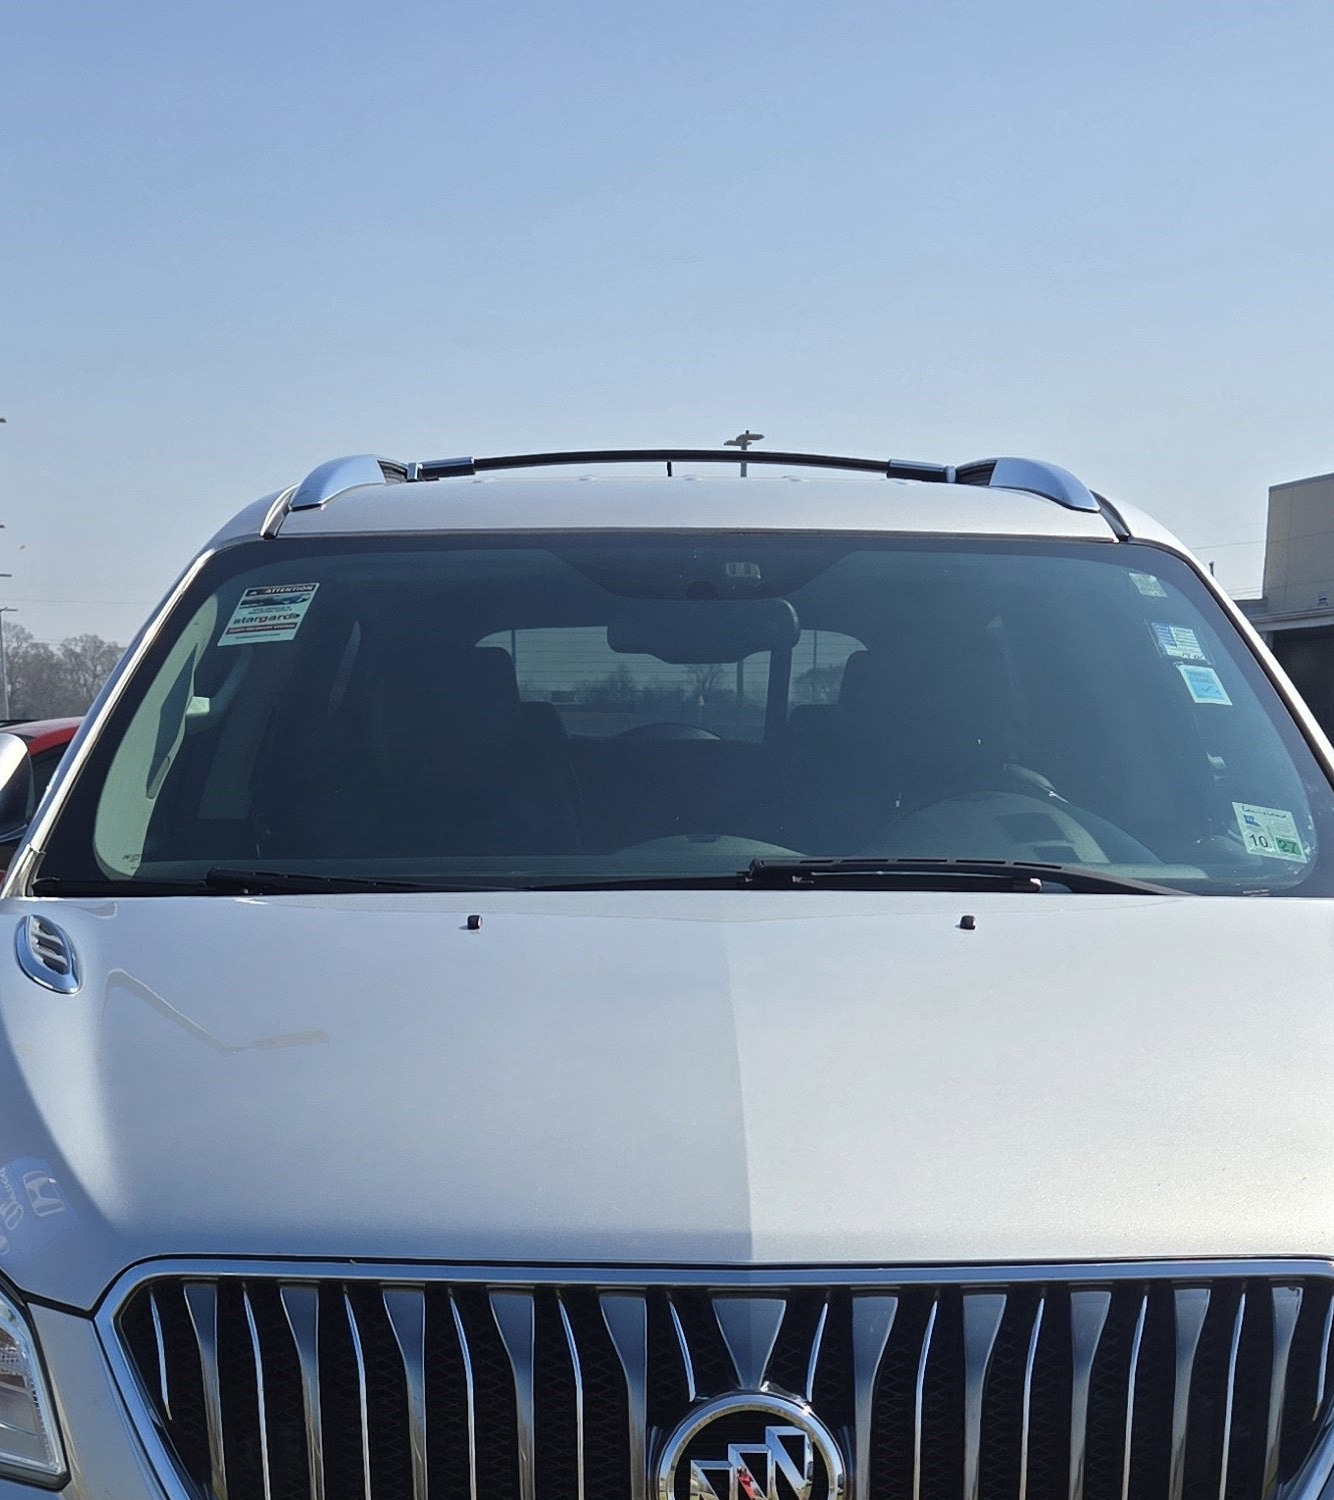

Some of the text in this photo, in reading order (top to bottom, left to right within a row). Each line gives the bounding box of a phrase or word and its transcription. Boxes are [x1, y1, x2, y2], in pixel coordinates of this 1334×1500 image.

[265, 585, 314, 594] ATTENTION
[1249, 834, 1297, 853] 10 27
